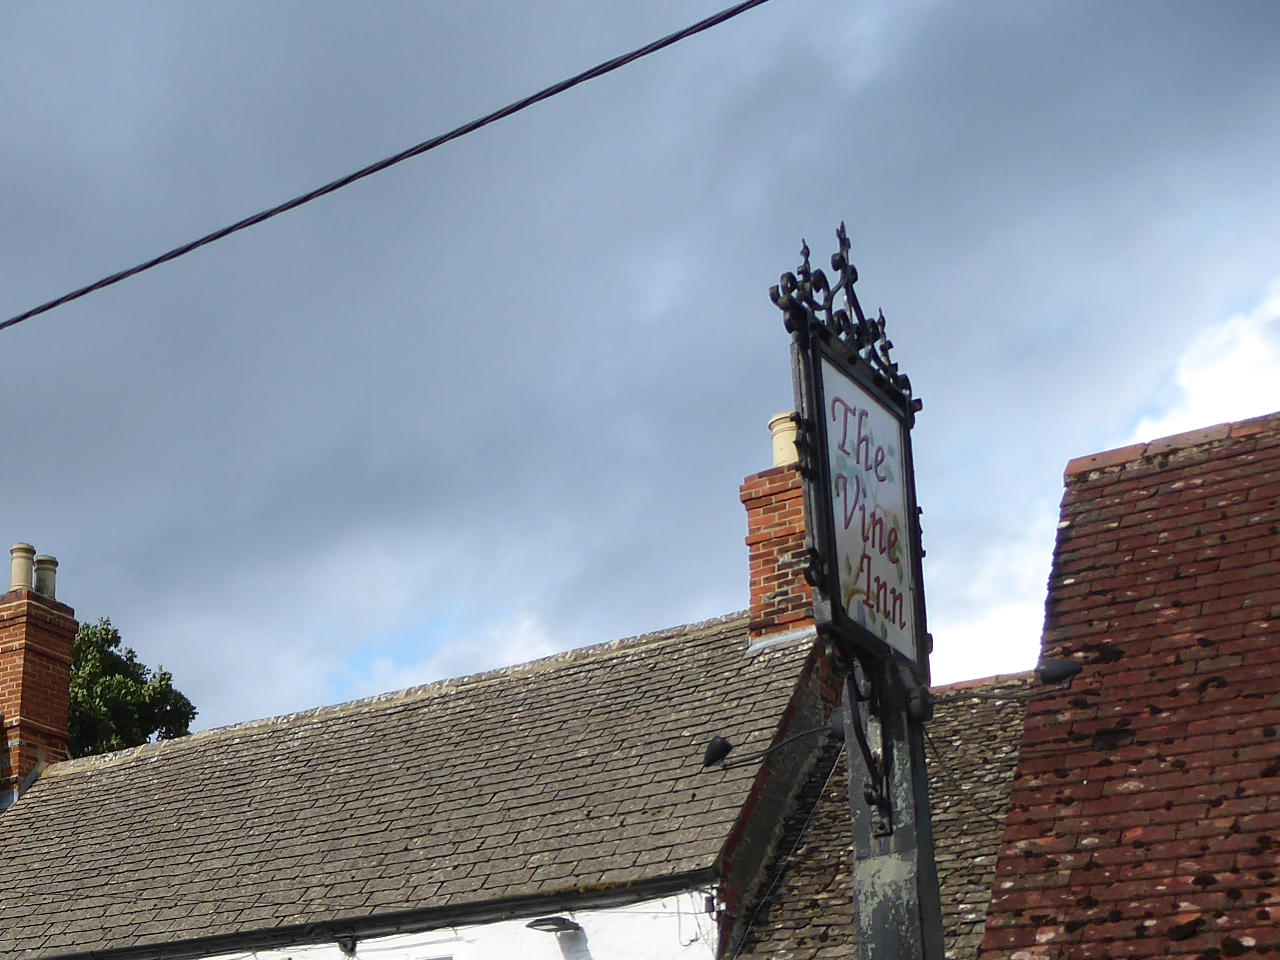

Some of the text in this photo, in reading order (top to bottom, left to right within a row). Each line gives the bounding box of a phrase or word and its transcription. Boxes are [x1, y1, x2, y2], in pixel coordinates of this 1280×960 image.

[831, 396, 887, 482] The
[835, 473, 900, 565] Vine
[859, 553, 906, 630] Inn
